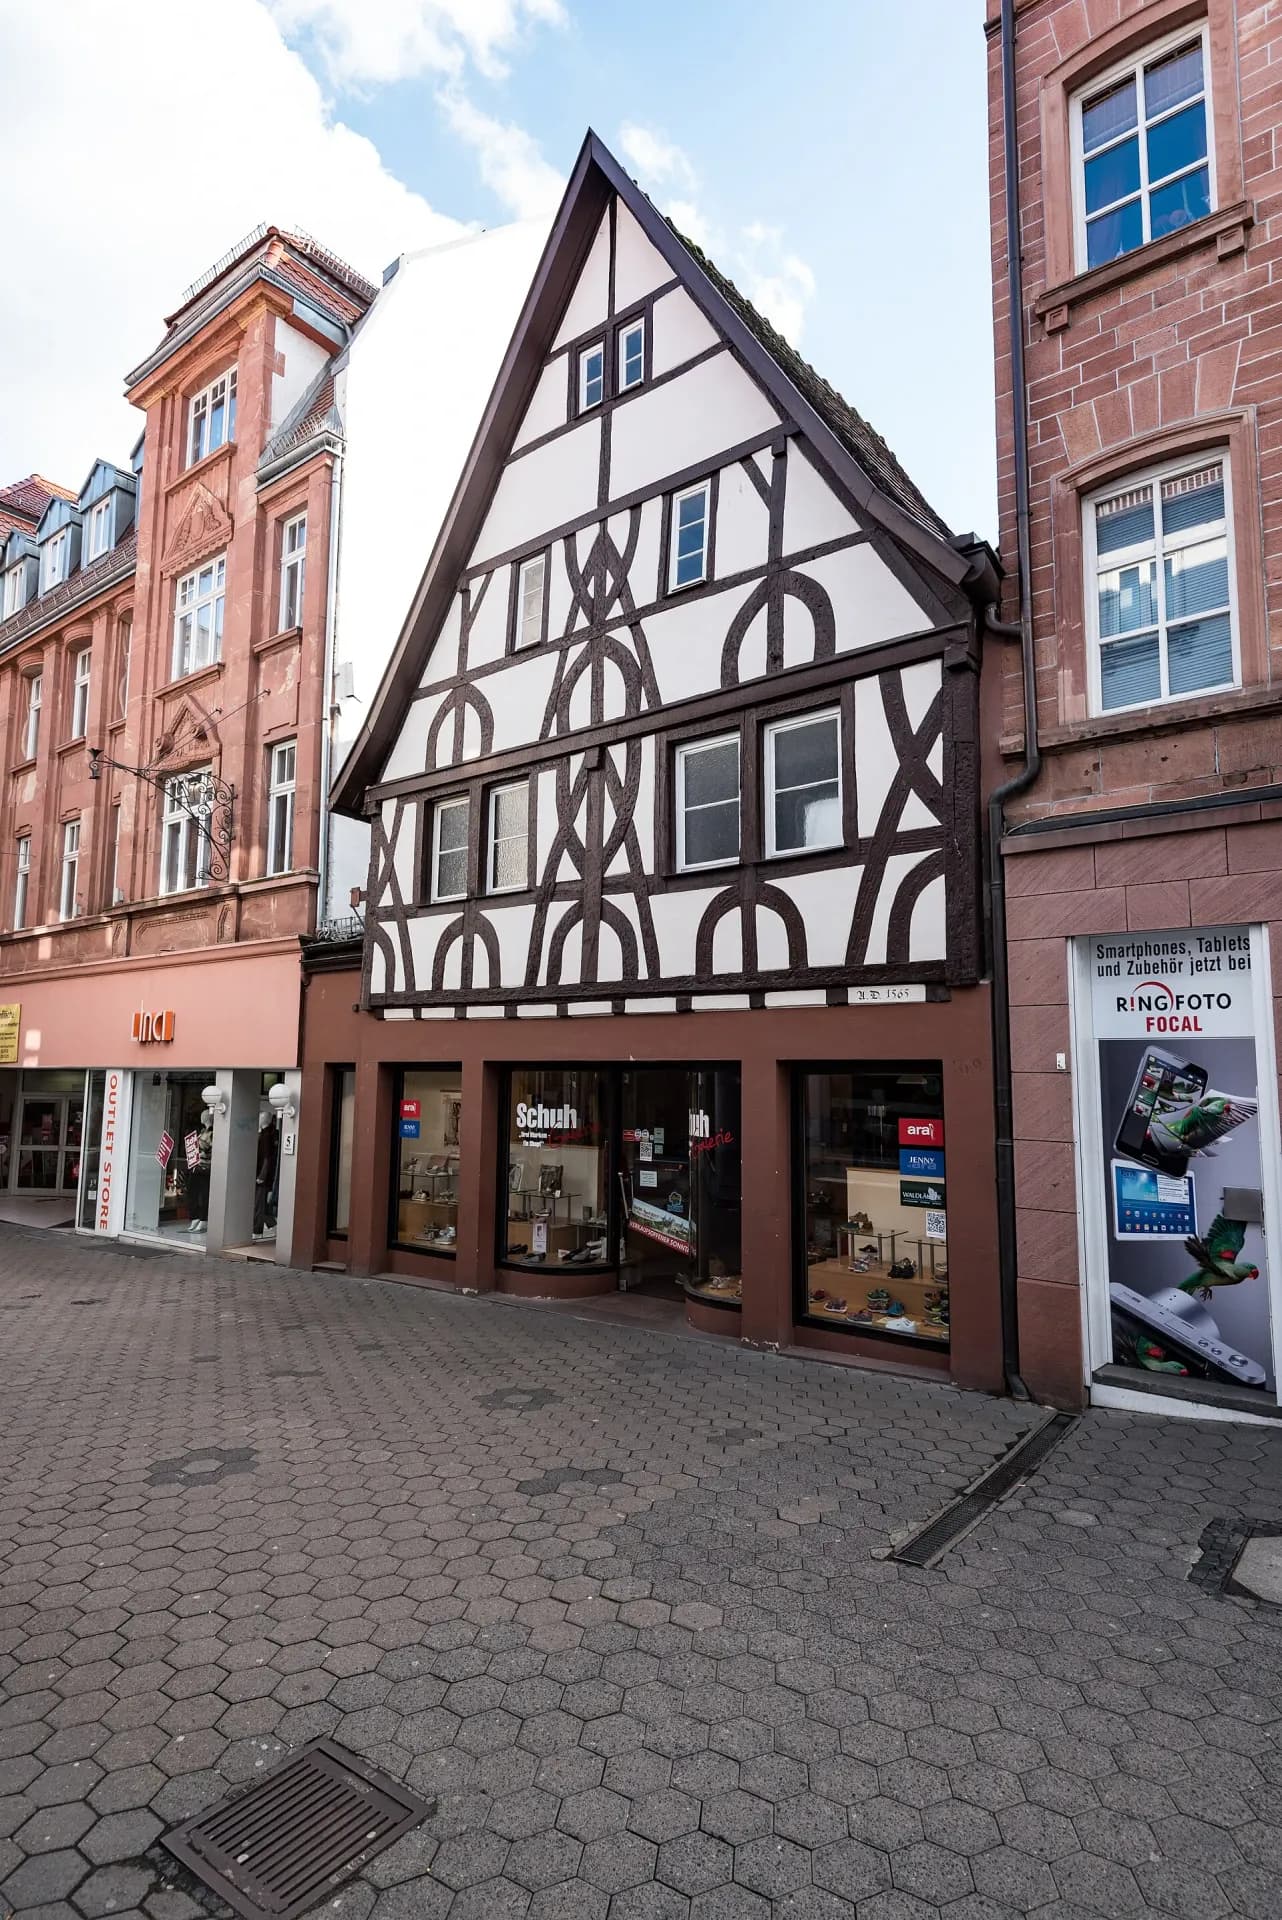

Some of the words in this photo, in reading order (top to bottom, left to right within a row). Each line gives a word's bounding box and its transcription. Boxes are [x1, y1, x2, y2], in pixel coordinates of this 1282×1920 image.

[1096, 941, 1192, 960] Smartphones,
[1196, 935, 1250, 953] Tablets
[1097, 961, 1121, 977] und
[1127, 957, 1184, 976] Zubehör
[1190, 955, 1222, 976] jetzt
[1228, 953, 1252, 971] bei
[887, 988, 909, 999] 1565
[1145, 1015, 1203, 1033] FOCAL
[105, 1074, 118, 1155] OUTLET
[516, 1102, 577, 1128] Schuh
[286, 1135, 291, 1147] 5
[907, 1125, 930, 1136] ara
[909, 1155, 936, 1164] JENNY
[99, 1161, 113, 1231] STORE
